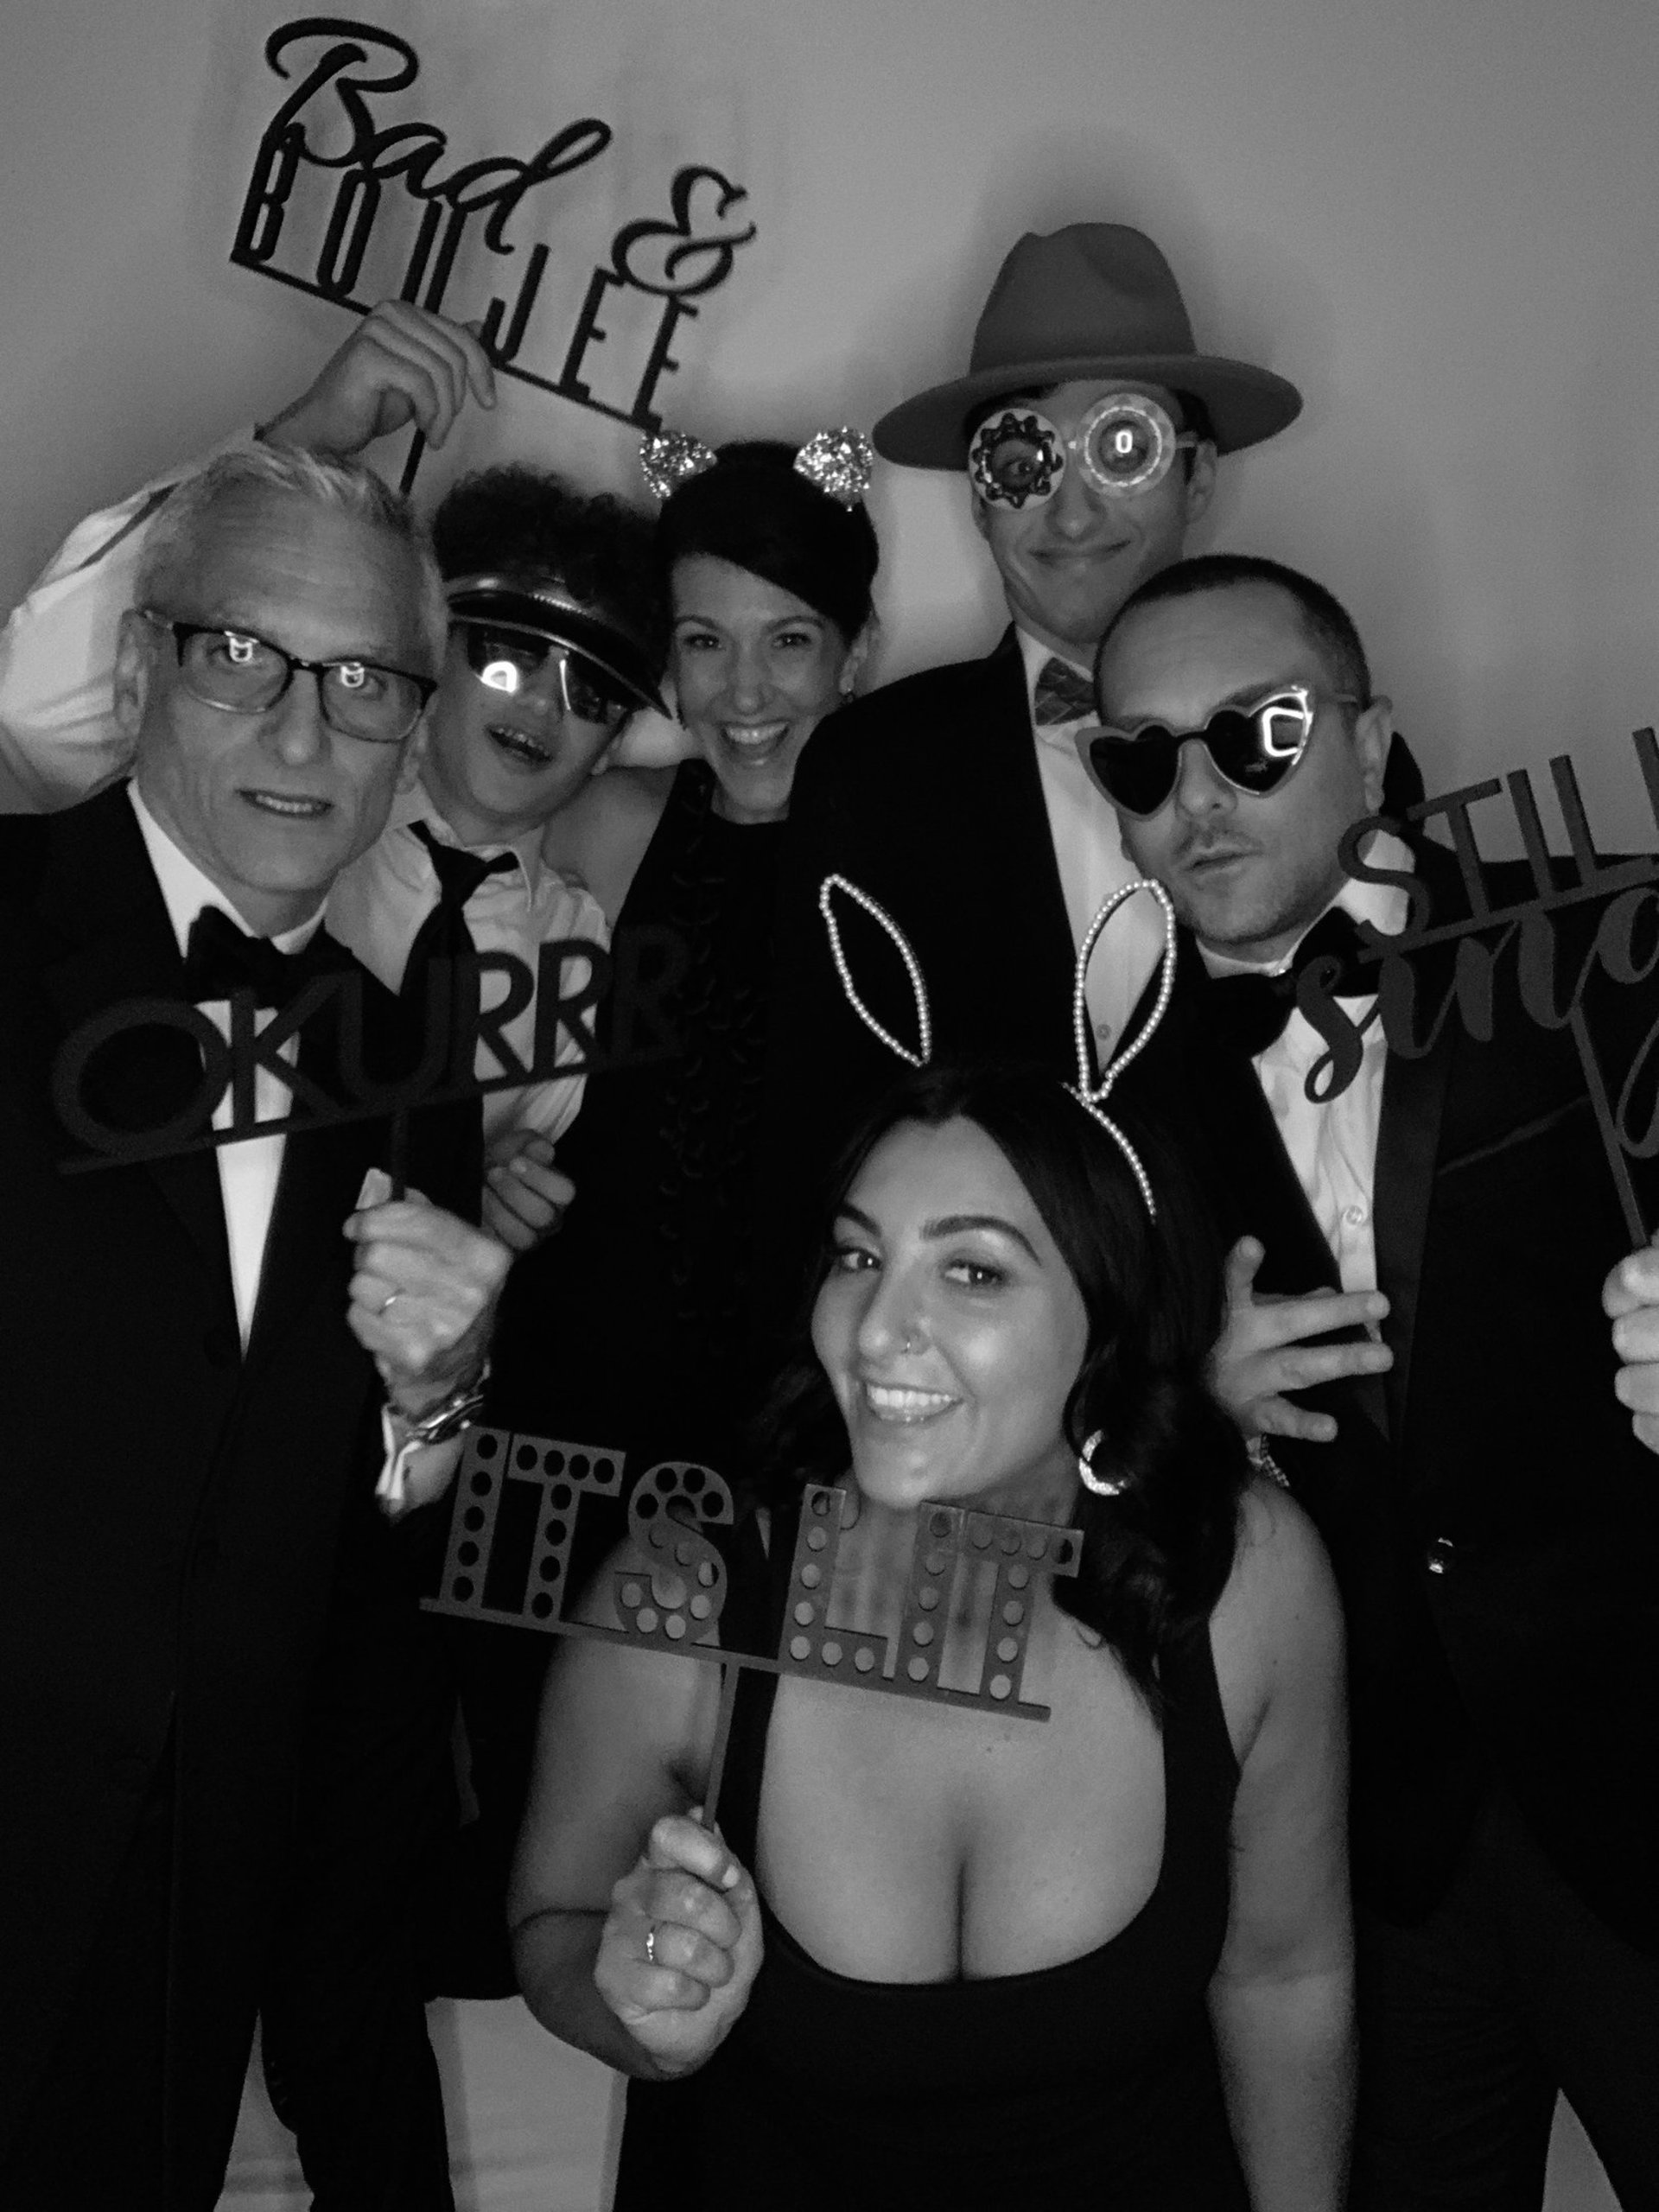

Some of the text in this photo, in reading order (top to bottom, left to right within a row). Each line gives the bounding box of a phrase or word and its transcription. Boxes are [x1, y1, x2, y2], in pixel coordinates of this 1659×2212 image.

[231, 123, 697, 435] BOUJEE
[265, 17, 756, 297] Bad &
[52, 923, 691, 1162] OKURRR
[439, 1424, 1085, 1711] ITS LIT
